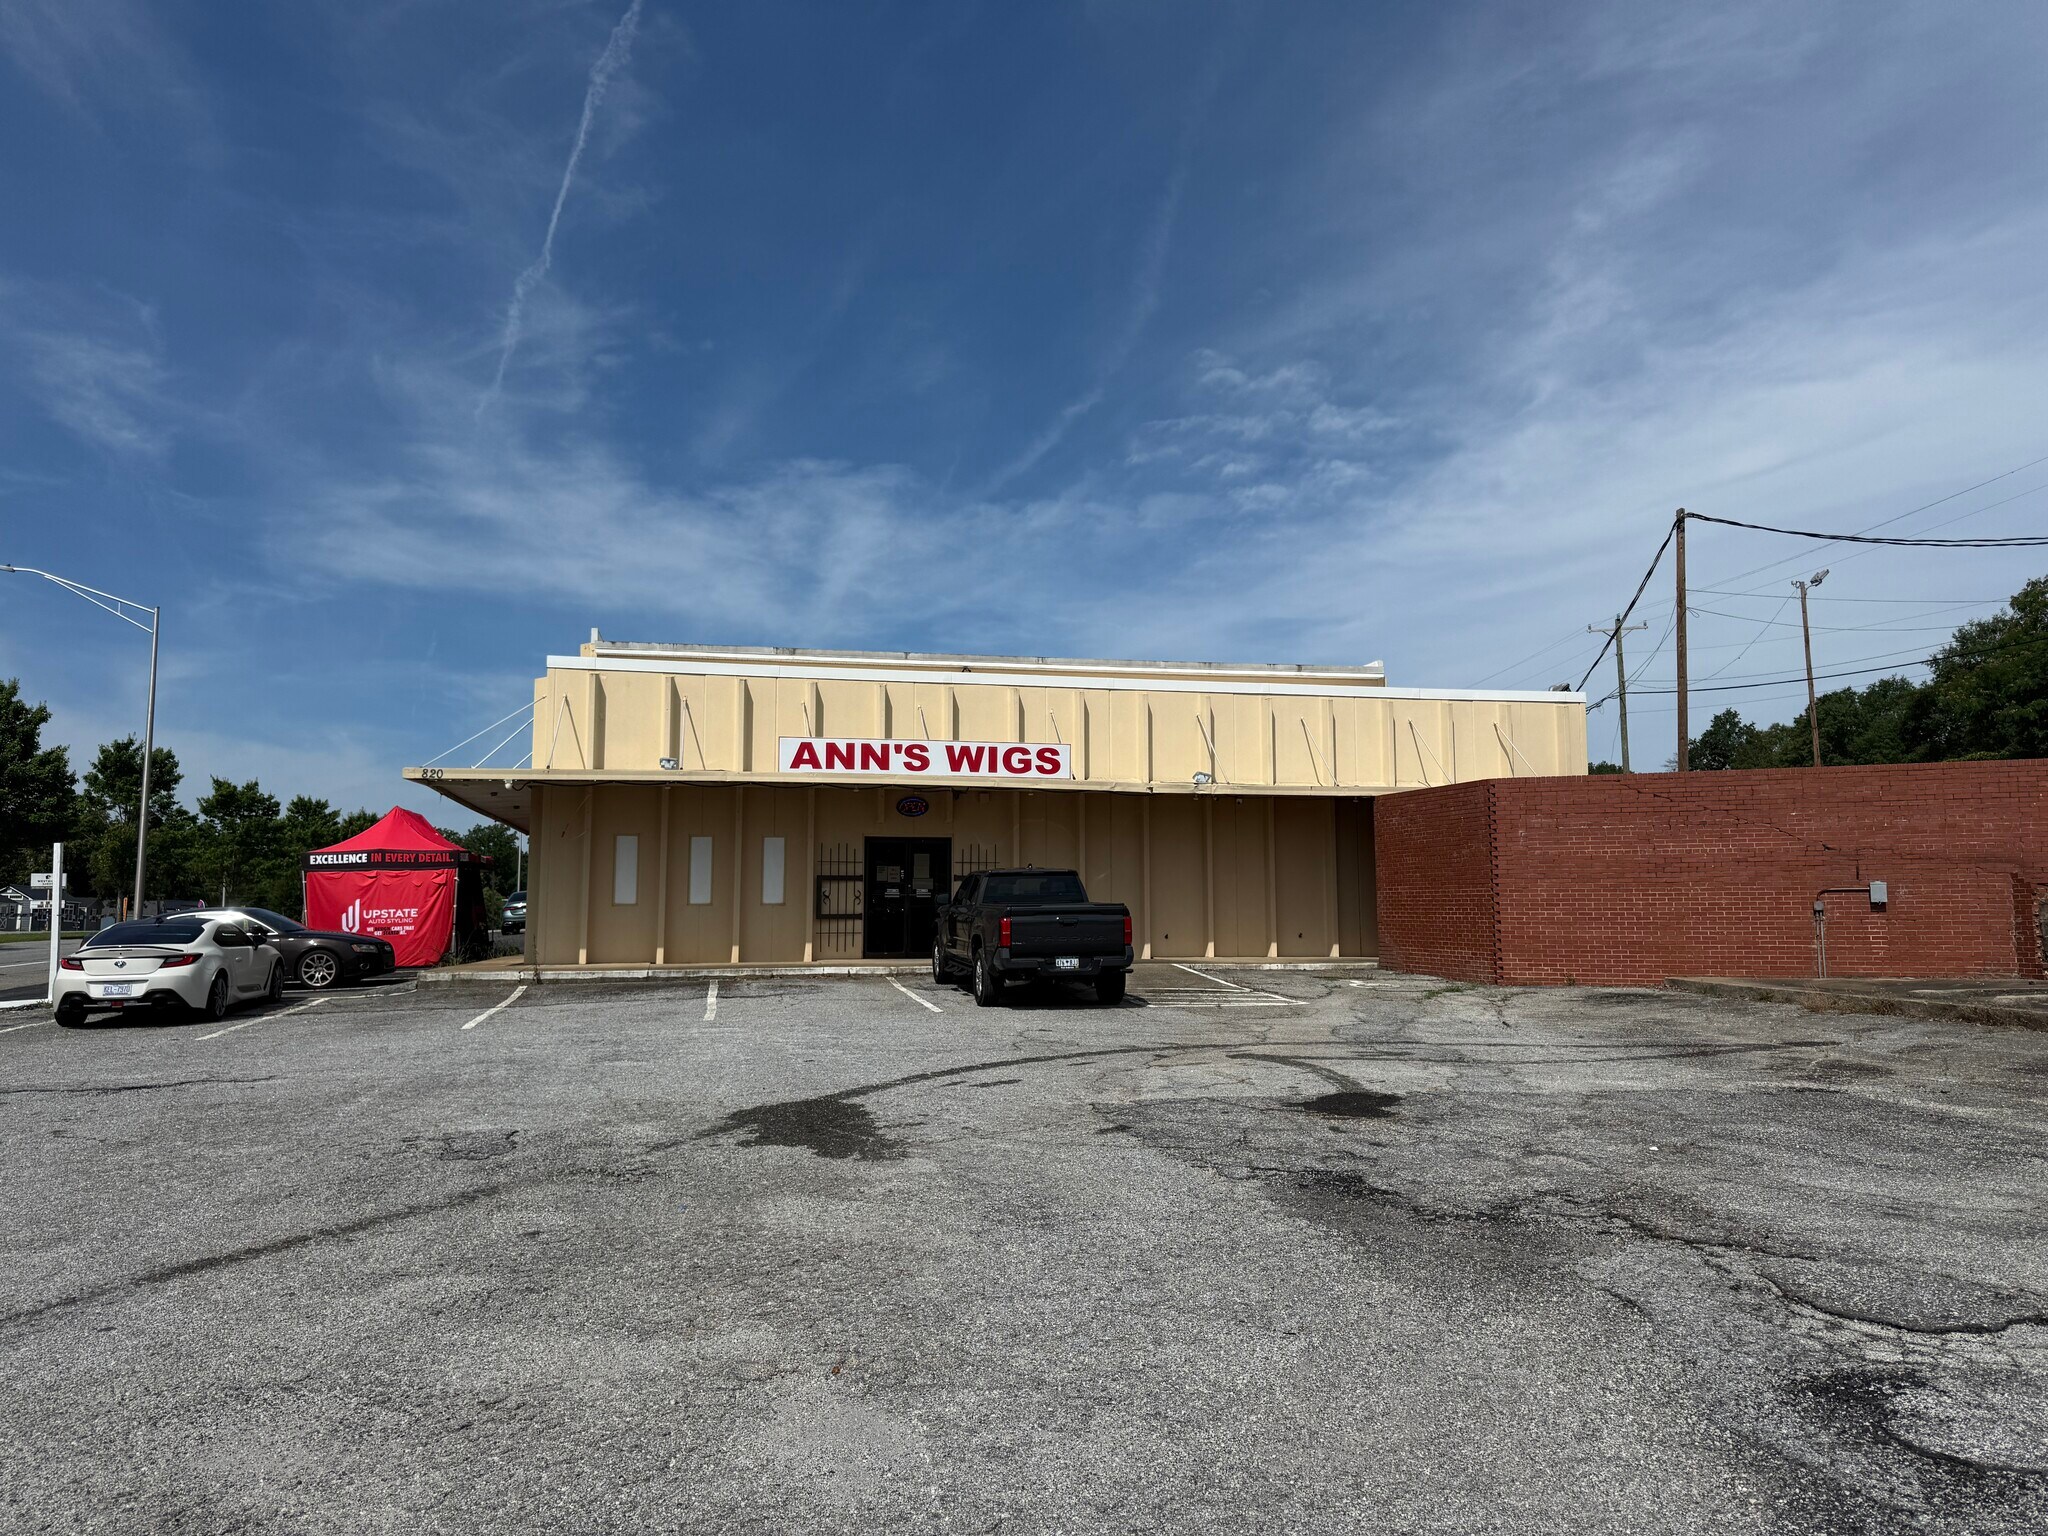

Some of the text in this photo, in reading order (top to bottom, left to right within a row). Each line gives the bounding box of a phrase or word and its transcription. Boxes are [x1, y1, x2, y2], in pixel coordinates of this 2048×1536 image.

[789, 741, 1062, 775] ANN'S WIGS
[421, 768, 444, 779] 820
[309, 852, 454, 865] EXCELLENCE IN EVERY DETAIL.
[363, 908, 419, 919] UPSTATE
